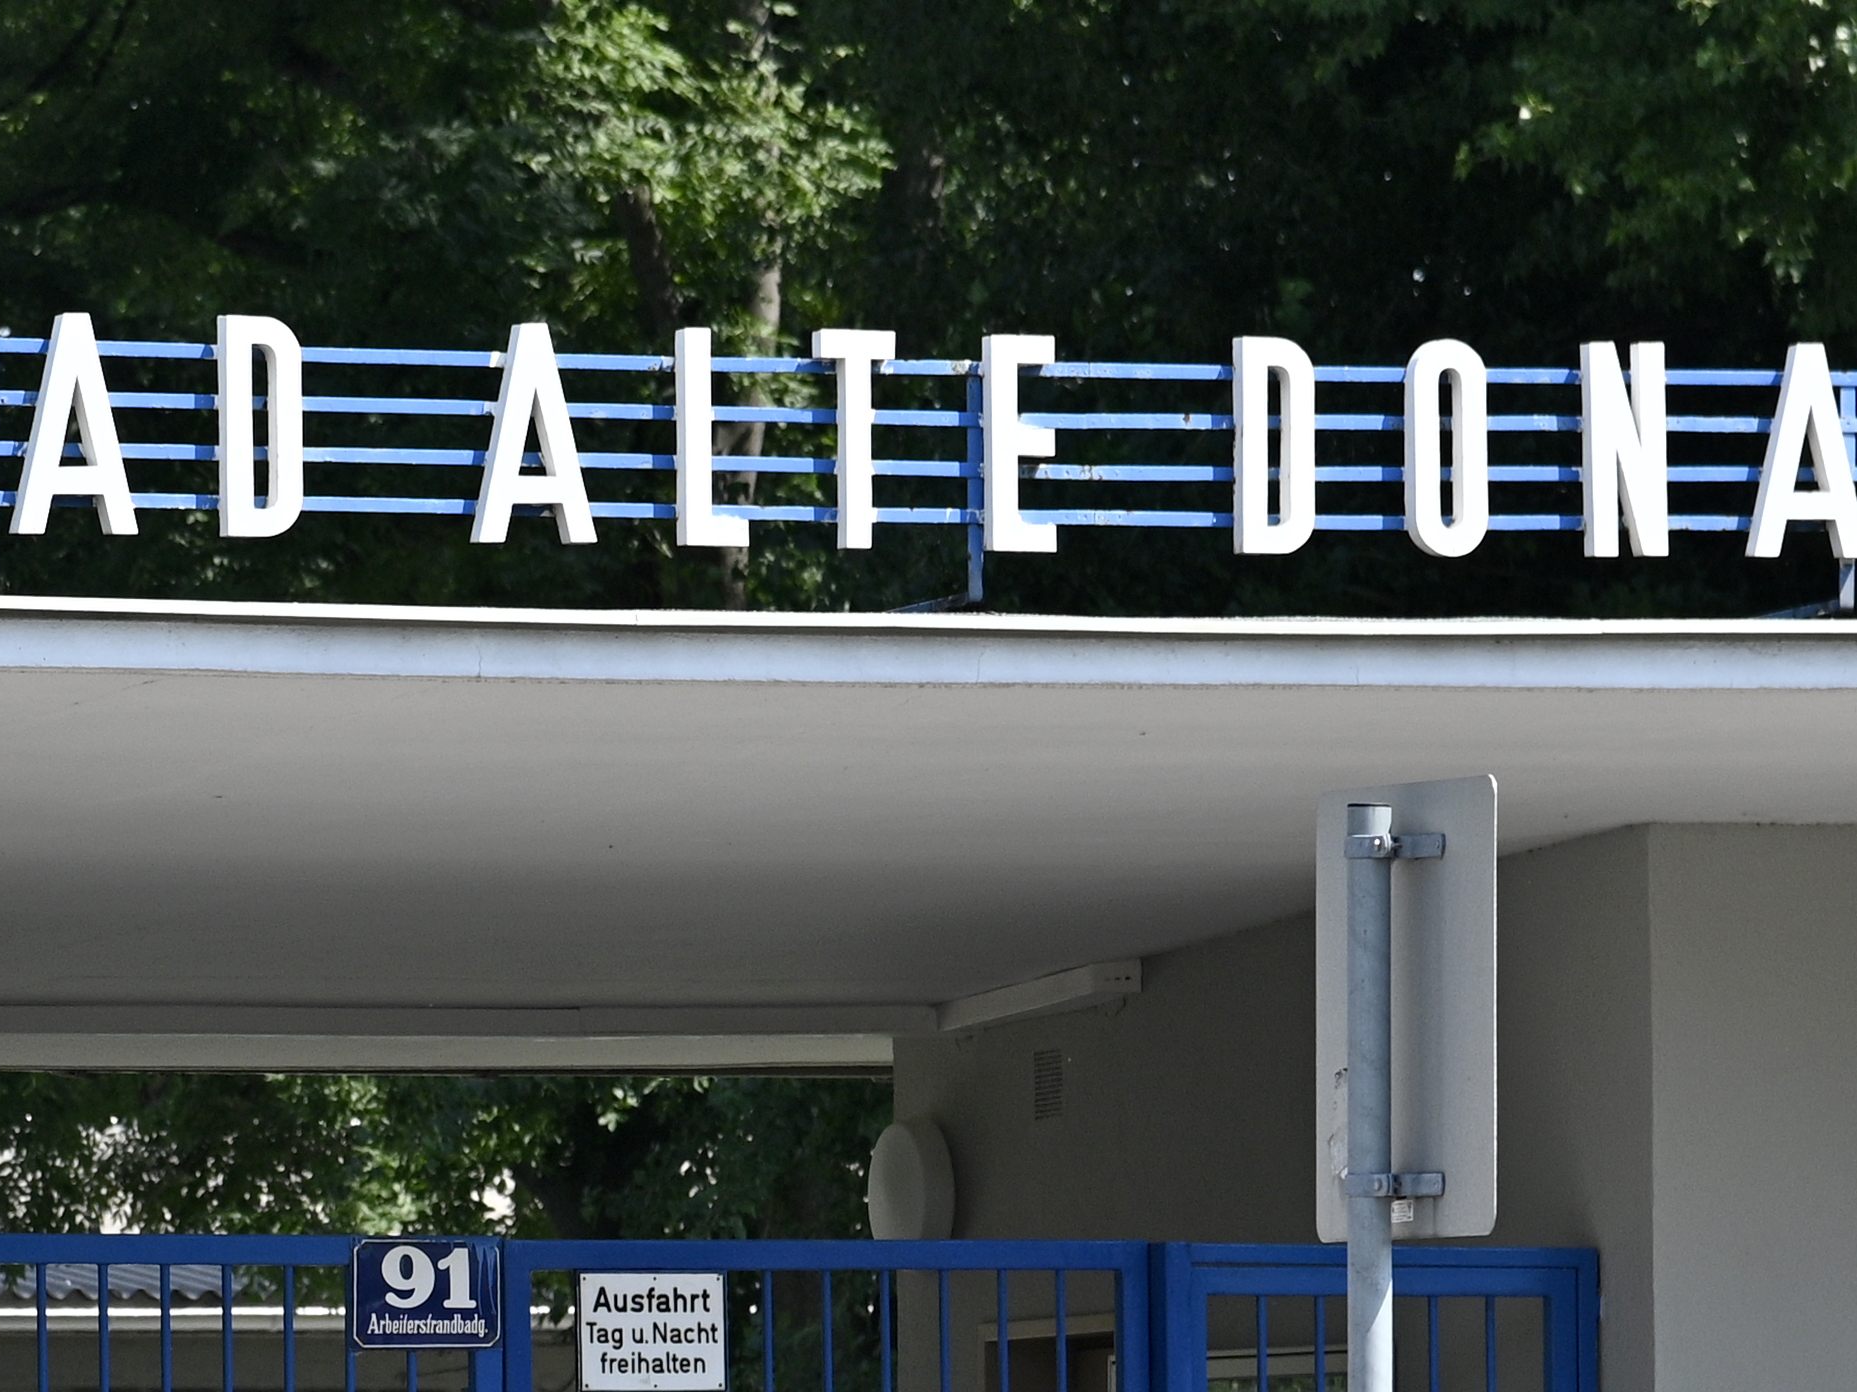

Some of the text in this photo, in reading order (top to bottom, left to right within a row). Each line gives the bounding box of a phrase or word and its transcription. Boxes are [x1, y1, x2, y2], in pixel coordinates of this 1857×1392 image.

[470, 322, 1057, 554] ALTE
[1232, 336, 1857, 559] DONA
[381, 1245, 478, 1310] 91
[593, 1286, 711, 1314] Ausfahrt
[367, 1312, 489, 1339] Arbeiterstrandbadg.
[586, 1322, 623, 1350] Tag
[600, 1351, 707, 1375] freihalten
